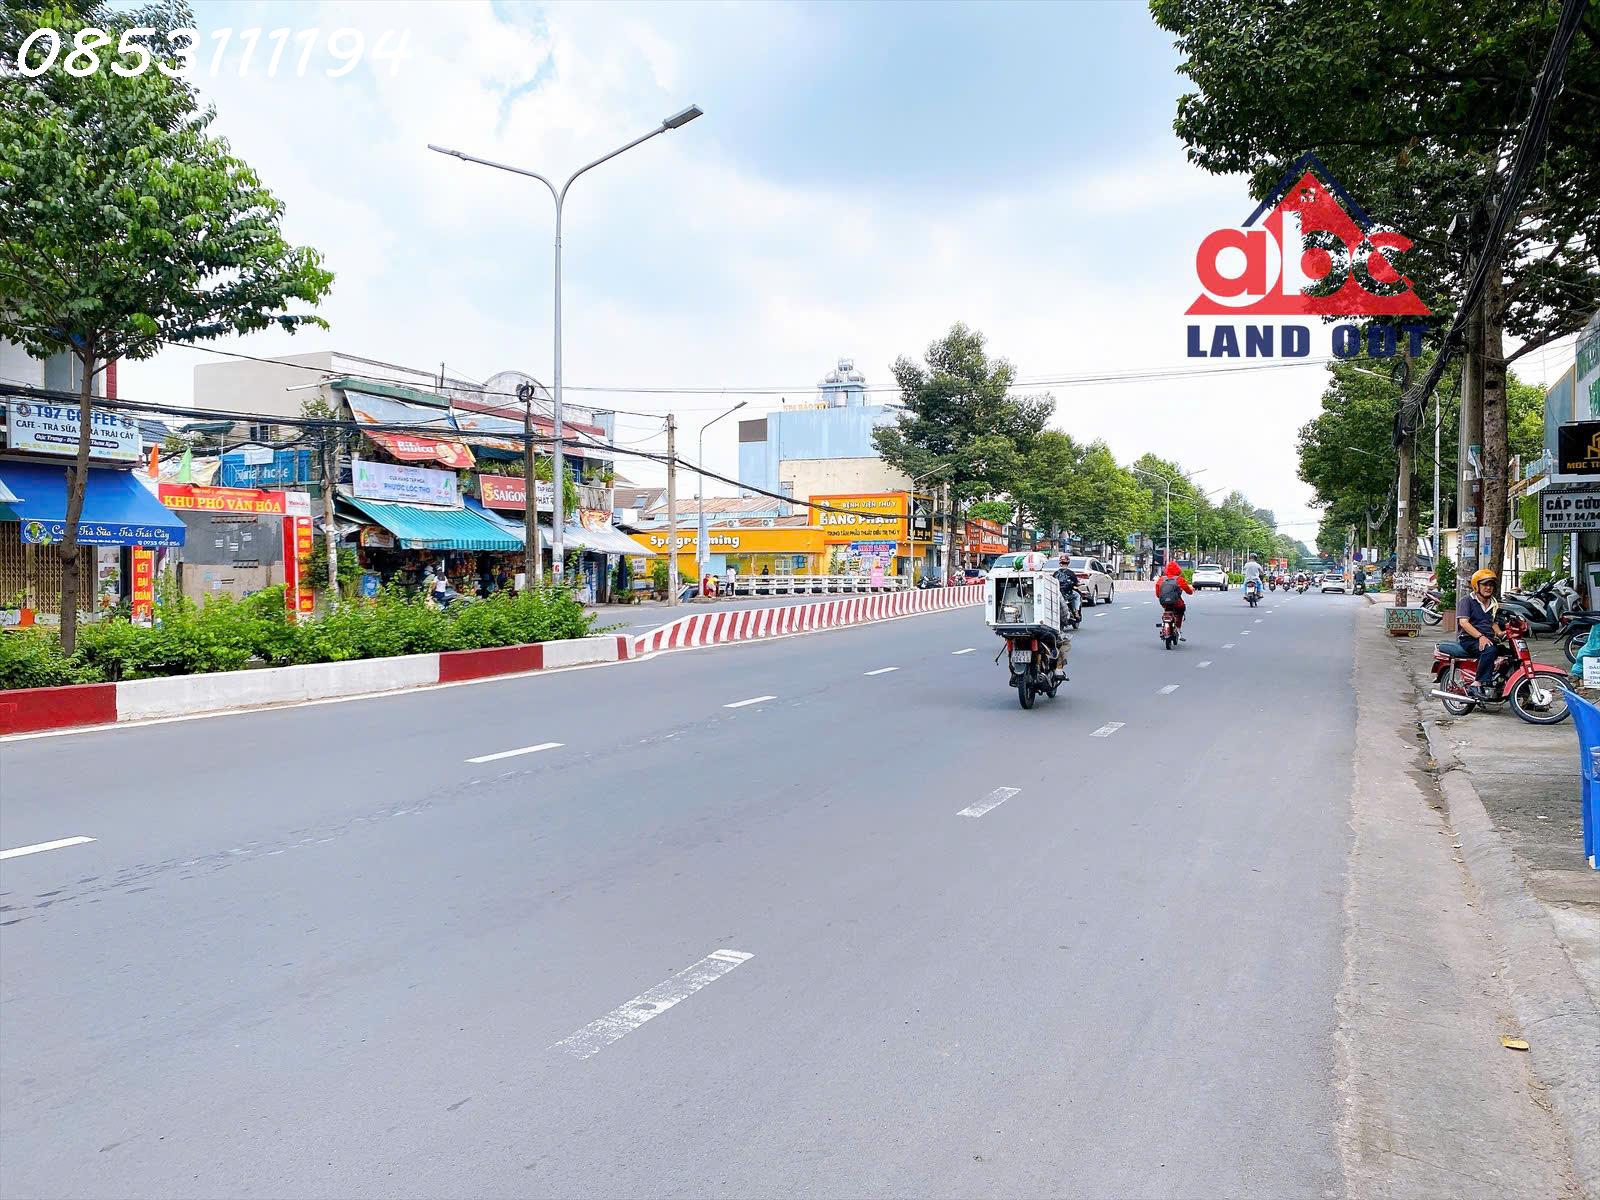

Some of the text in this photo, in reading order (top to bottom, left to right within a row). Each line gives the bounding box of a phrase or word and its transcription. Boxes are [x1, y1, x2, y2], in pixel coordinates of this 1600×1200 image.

[16, 420, 35, 429] CAFE
[493, 488, 526, 503] SAIGON
[1546, 496, 1572, 510] CẤP
[163, 496, 194, 508] KHU
[197, 496, 224, 508] PHỐ
[255, 498, 281, 512] HÓA
[676, 534, 740, 549] groming
